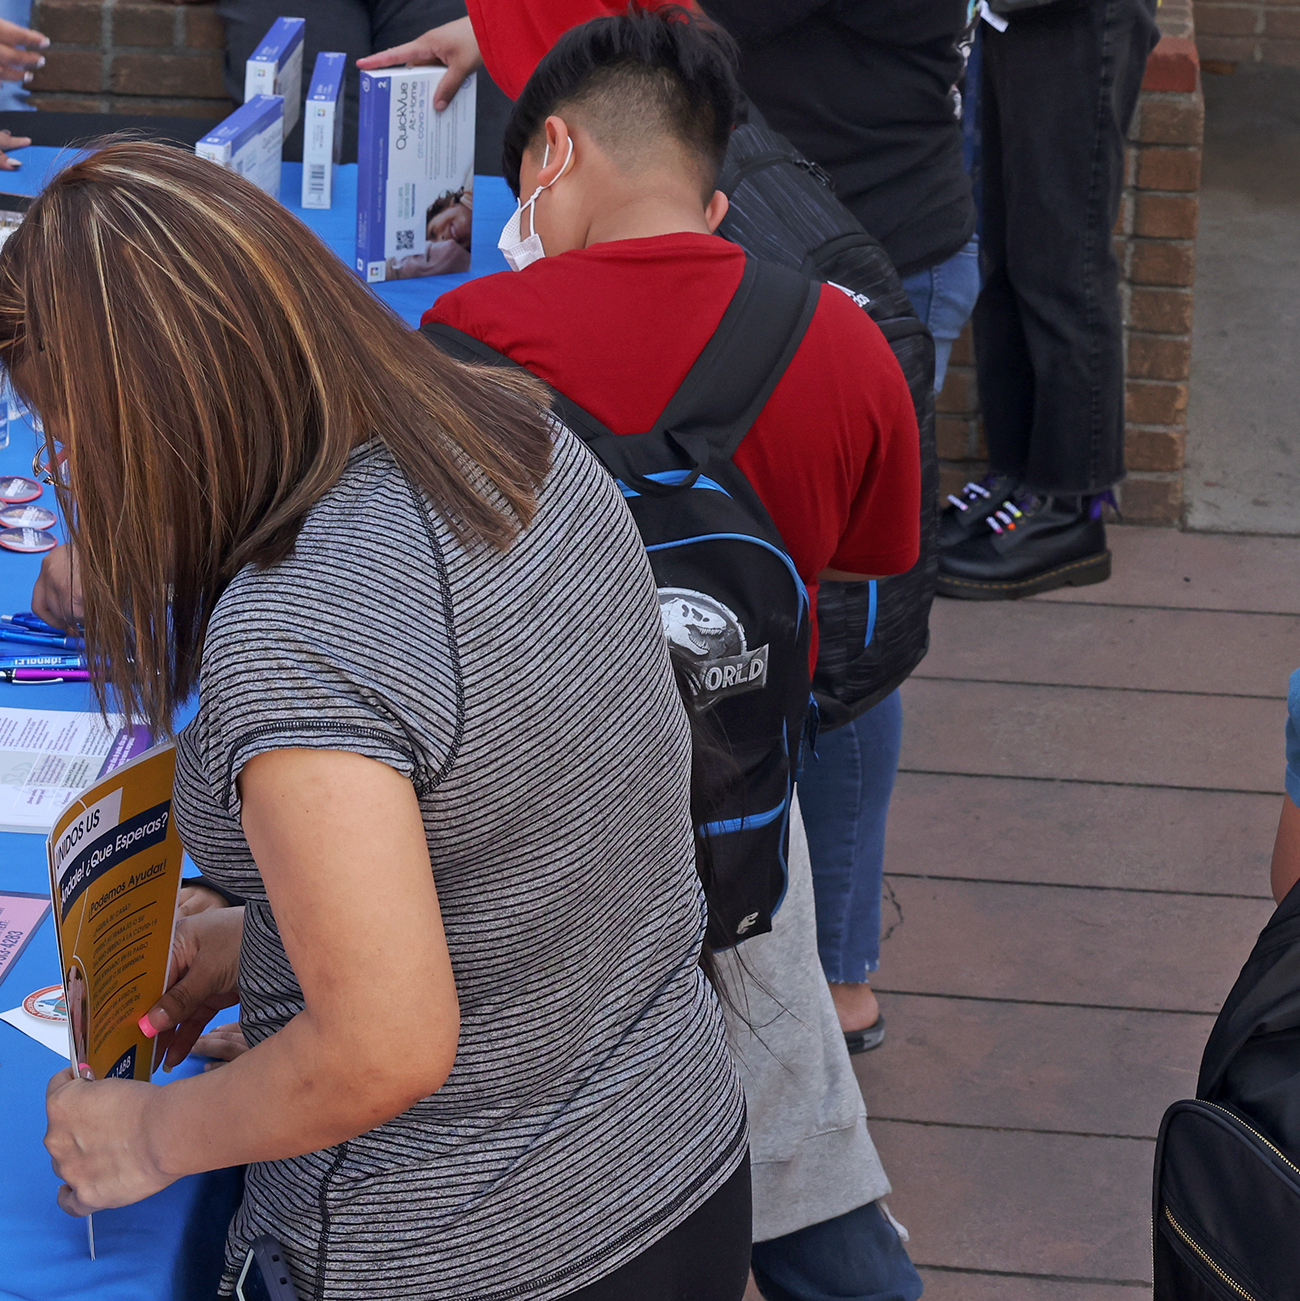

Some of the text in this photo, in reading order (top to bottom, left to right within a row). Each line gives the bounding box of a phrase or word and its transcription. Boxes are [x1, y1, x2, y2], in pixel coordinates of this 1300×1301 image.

[396, 82, 409, 151] QuickVue
[408, 81, 418, 131] At-Home
[85, 843, 113, 877] ¿Que
[115, 811, 169, 852] Esperas?
[86, 809, 101, 833] US
[88, 858, 167, 920] ¡Podemos Ayudar!
